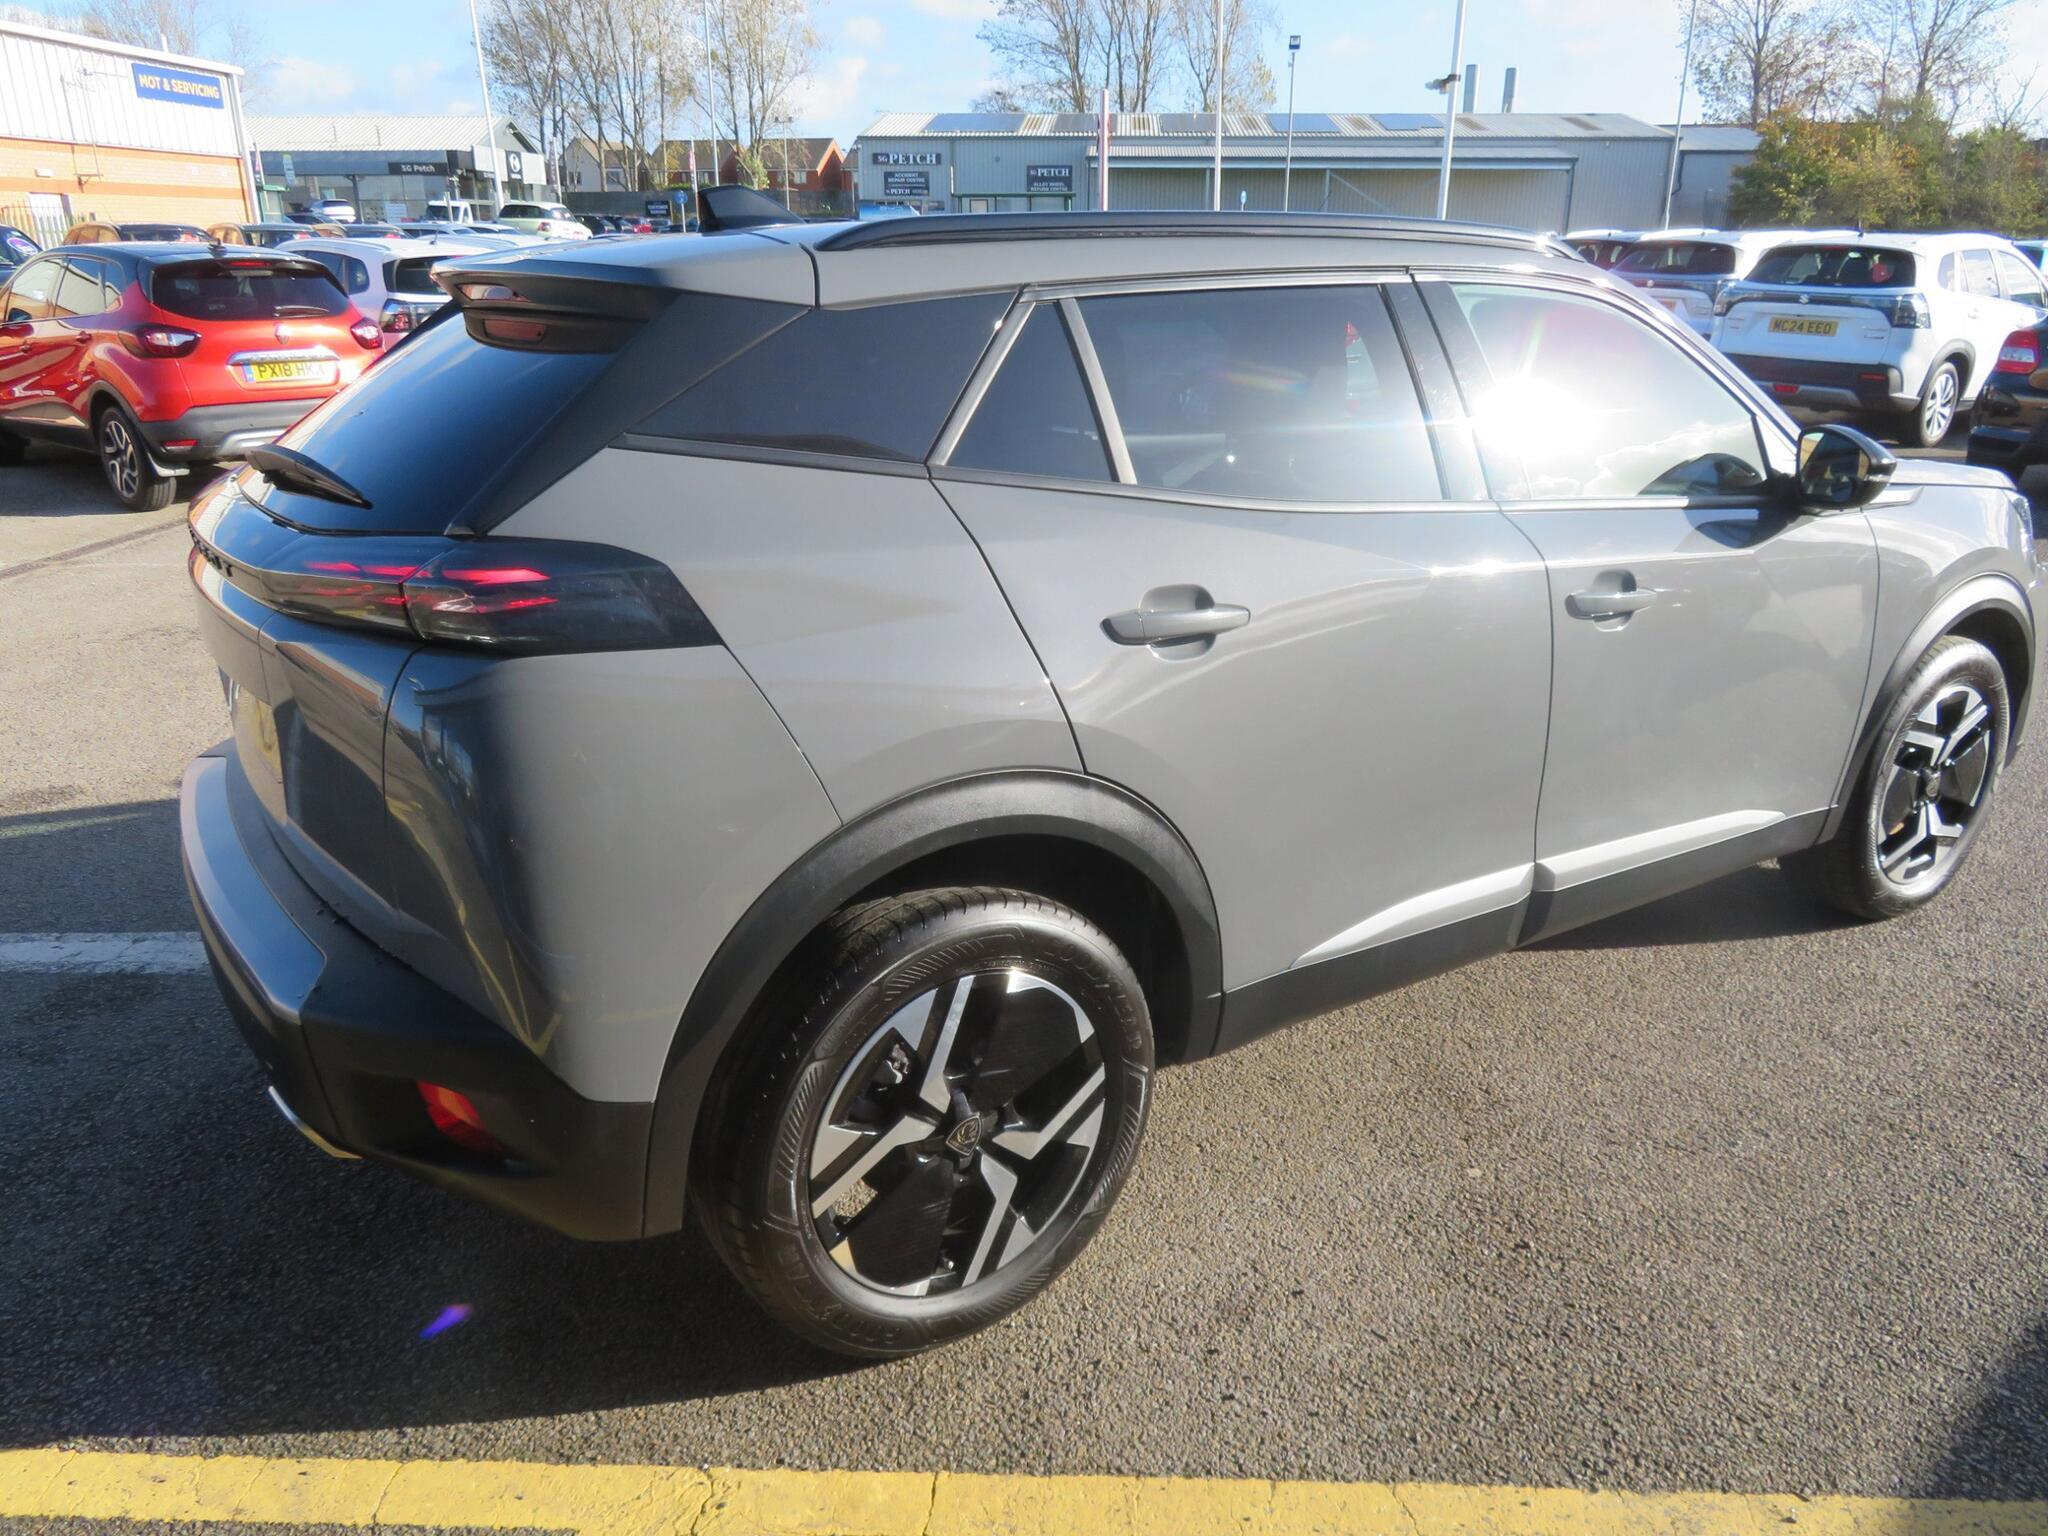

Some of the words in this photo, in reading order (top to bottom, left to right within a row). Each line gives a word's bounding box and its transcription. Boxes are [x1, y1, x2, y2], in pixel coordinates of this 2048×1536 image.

[139, 74, 160, 89] MOT
[171, 79, 219, 98] SERVICING
[889, 153, 936, 164] PETCH
[413, 164, 435, 172] Petch
[1037, 168, 1069, 176] PETCH
[257, 364, 292, 379] PX18
